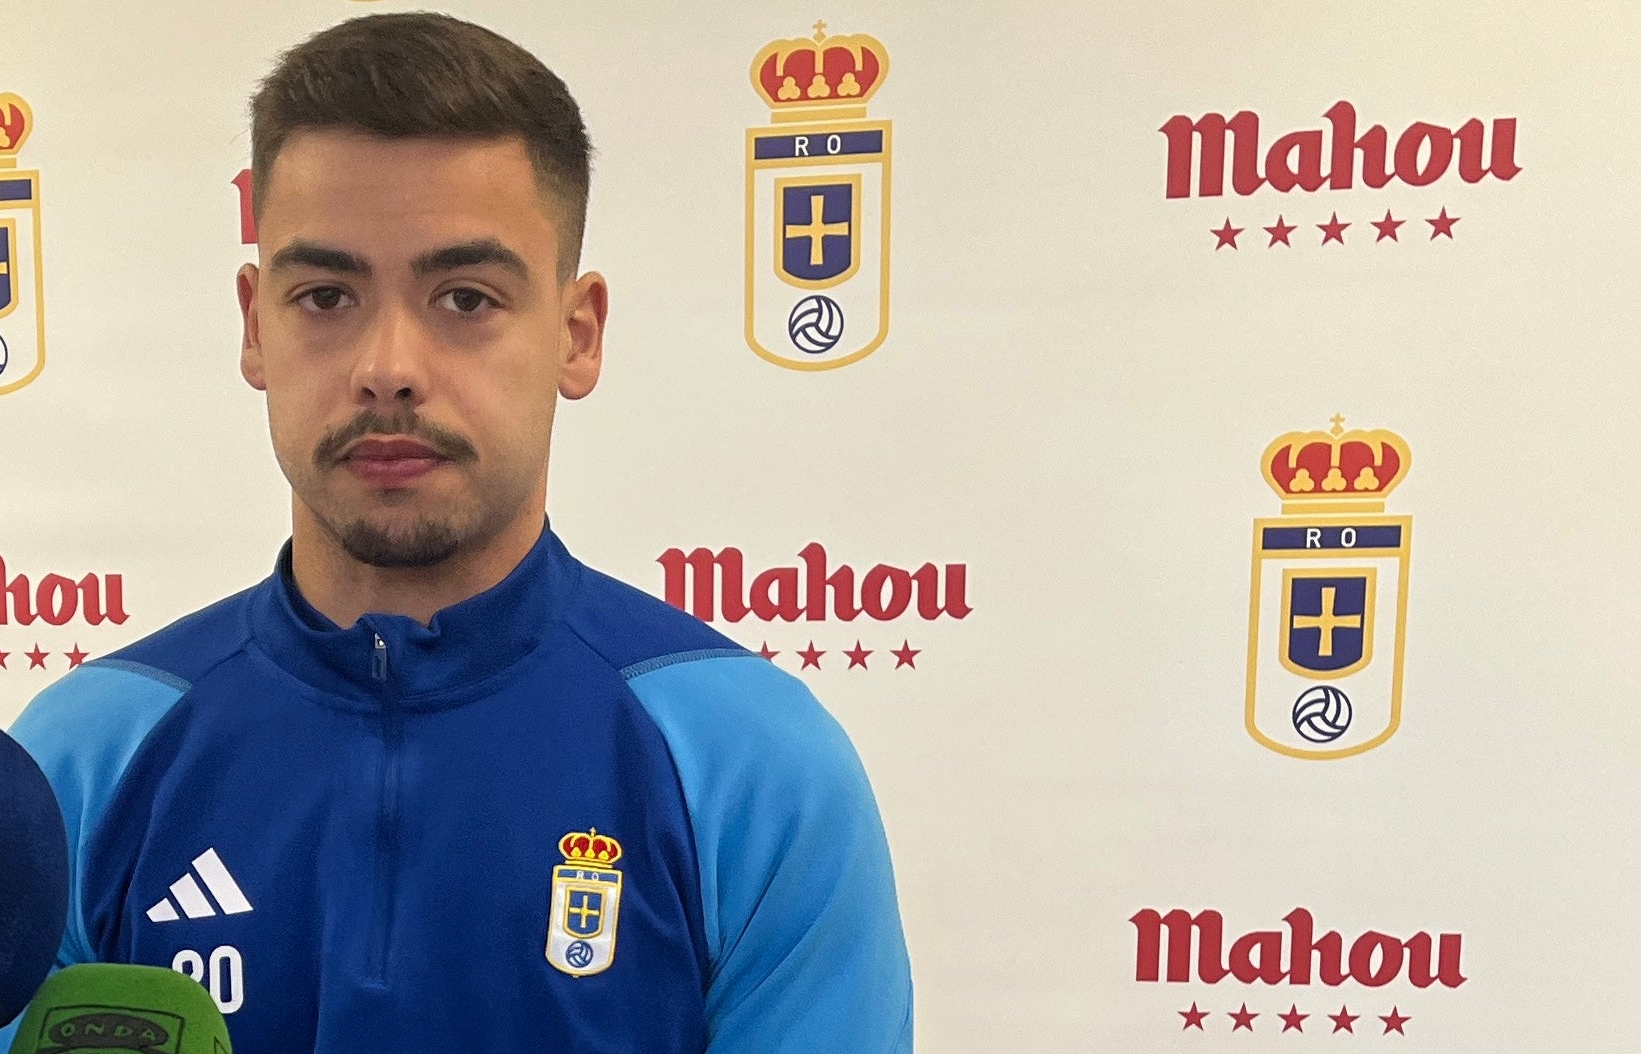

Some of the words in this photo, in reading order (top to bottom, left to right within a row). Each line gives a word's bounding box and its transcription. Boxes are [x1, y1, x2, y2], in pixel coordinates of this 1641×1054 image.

[1158, 100, 1523, 200] Mahou
[655, 542, 974, 623] Mahou
[1128, 907, 1468, 989] Mahou
[60, 1021, 156, 1042] ONDA
